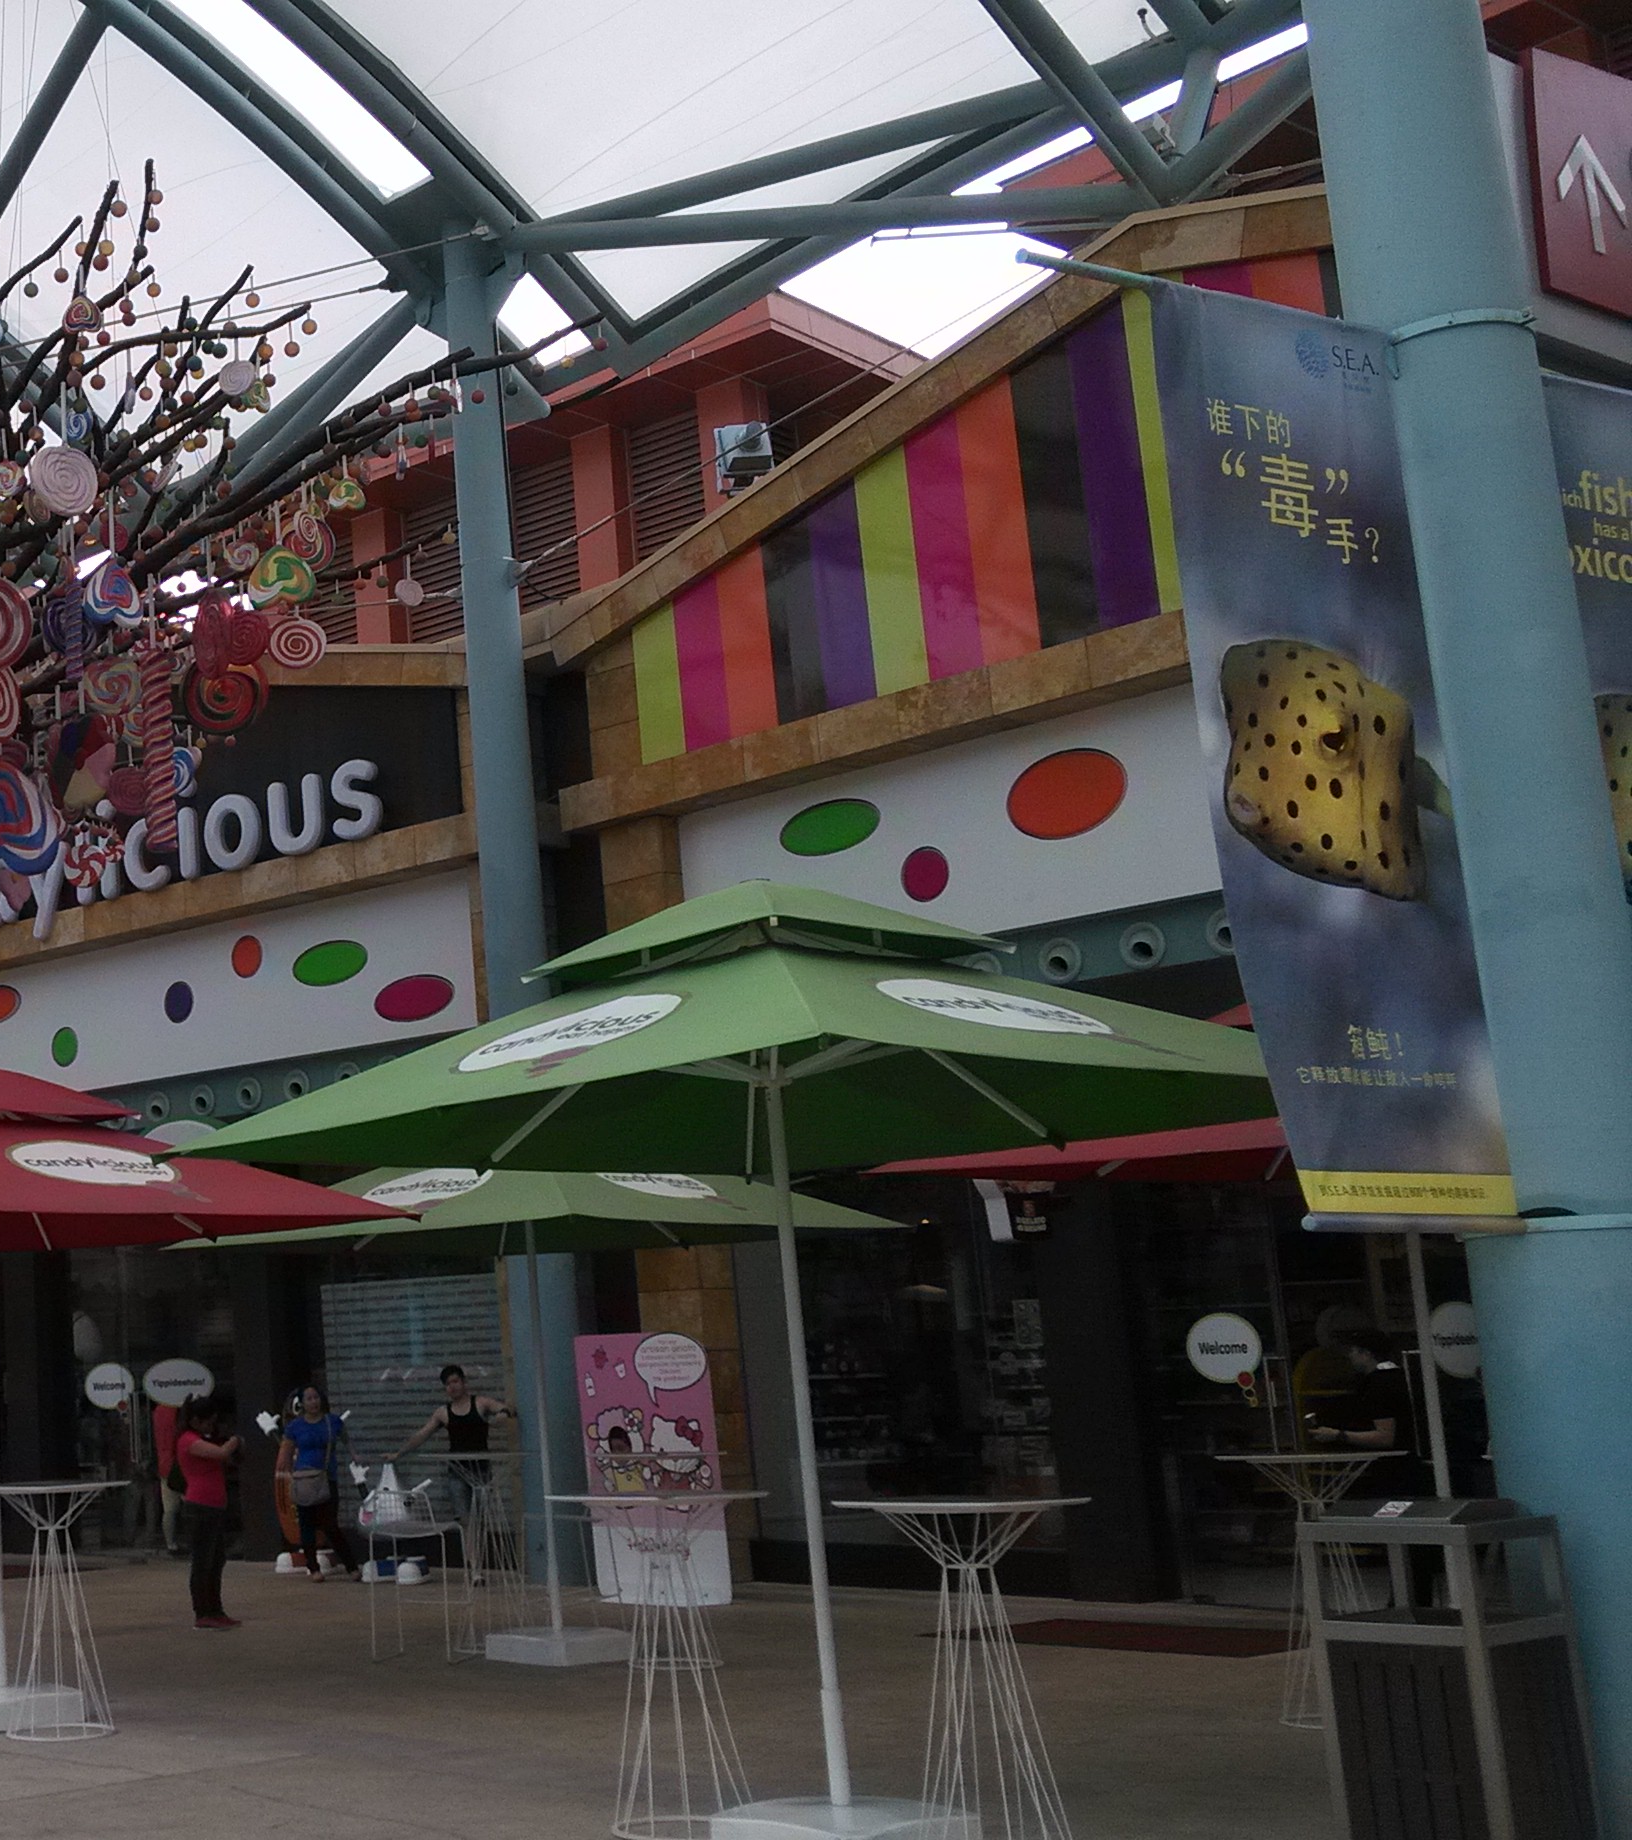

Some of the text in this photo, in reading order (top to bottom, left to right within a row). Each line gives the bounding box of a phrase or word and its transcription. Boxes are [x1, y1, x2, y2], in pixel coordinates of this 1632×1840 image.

[1332, 346, 1380, 375] S.E.A.
[1206, 398, 1291, 448] 谁下的
[1594, 517, 1618, 538] has
[1569, 538, 1632, 584] xico
[1198, 1342, 1248, 1355] Welcome
[93, 1381, 125, 1391] Welcome
